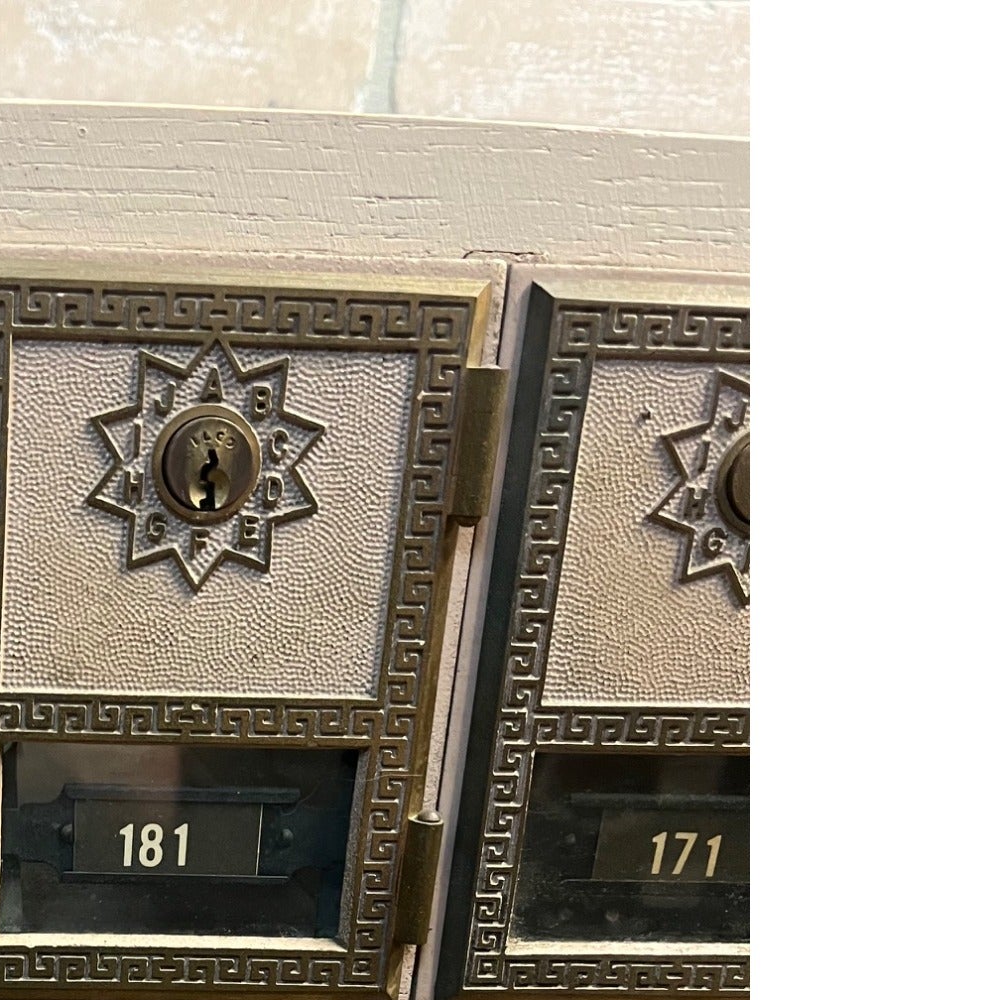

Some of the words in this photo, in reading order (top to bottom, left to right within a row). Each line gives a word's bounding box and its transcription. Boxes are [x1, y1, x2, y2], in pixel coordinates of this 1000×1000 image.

[153, 381, 176, 416] J
[200, 367, 224, 404] A
[252, 385, 273, 421] B
[718, 398, 748, 436] J
[268, 429, 290, 463] C
[123, 469, 145, 504] H
[263, 475, 285, 509] D
[682, 484, 711, 520] H
[145, 511, 167, 544] G
[190, 527, 210, 558] F
[239, 515, 261, 546] E
[702, 527, 729, 559] G
[120, 824, 189, 867] 181
[652, 832, 721, 876] 171
